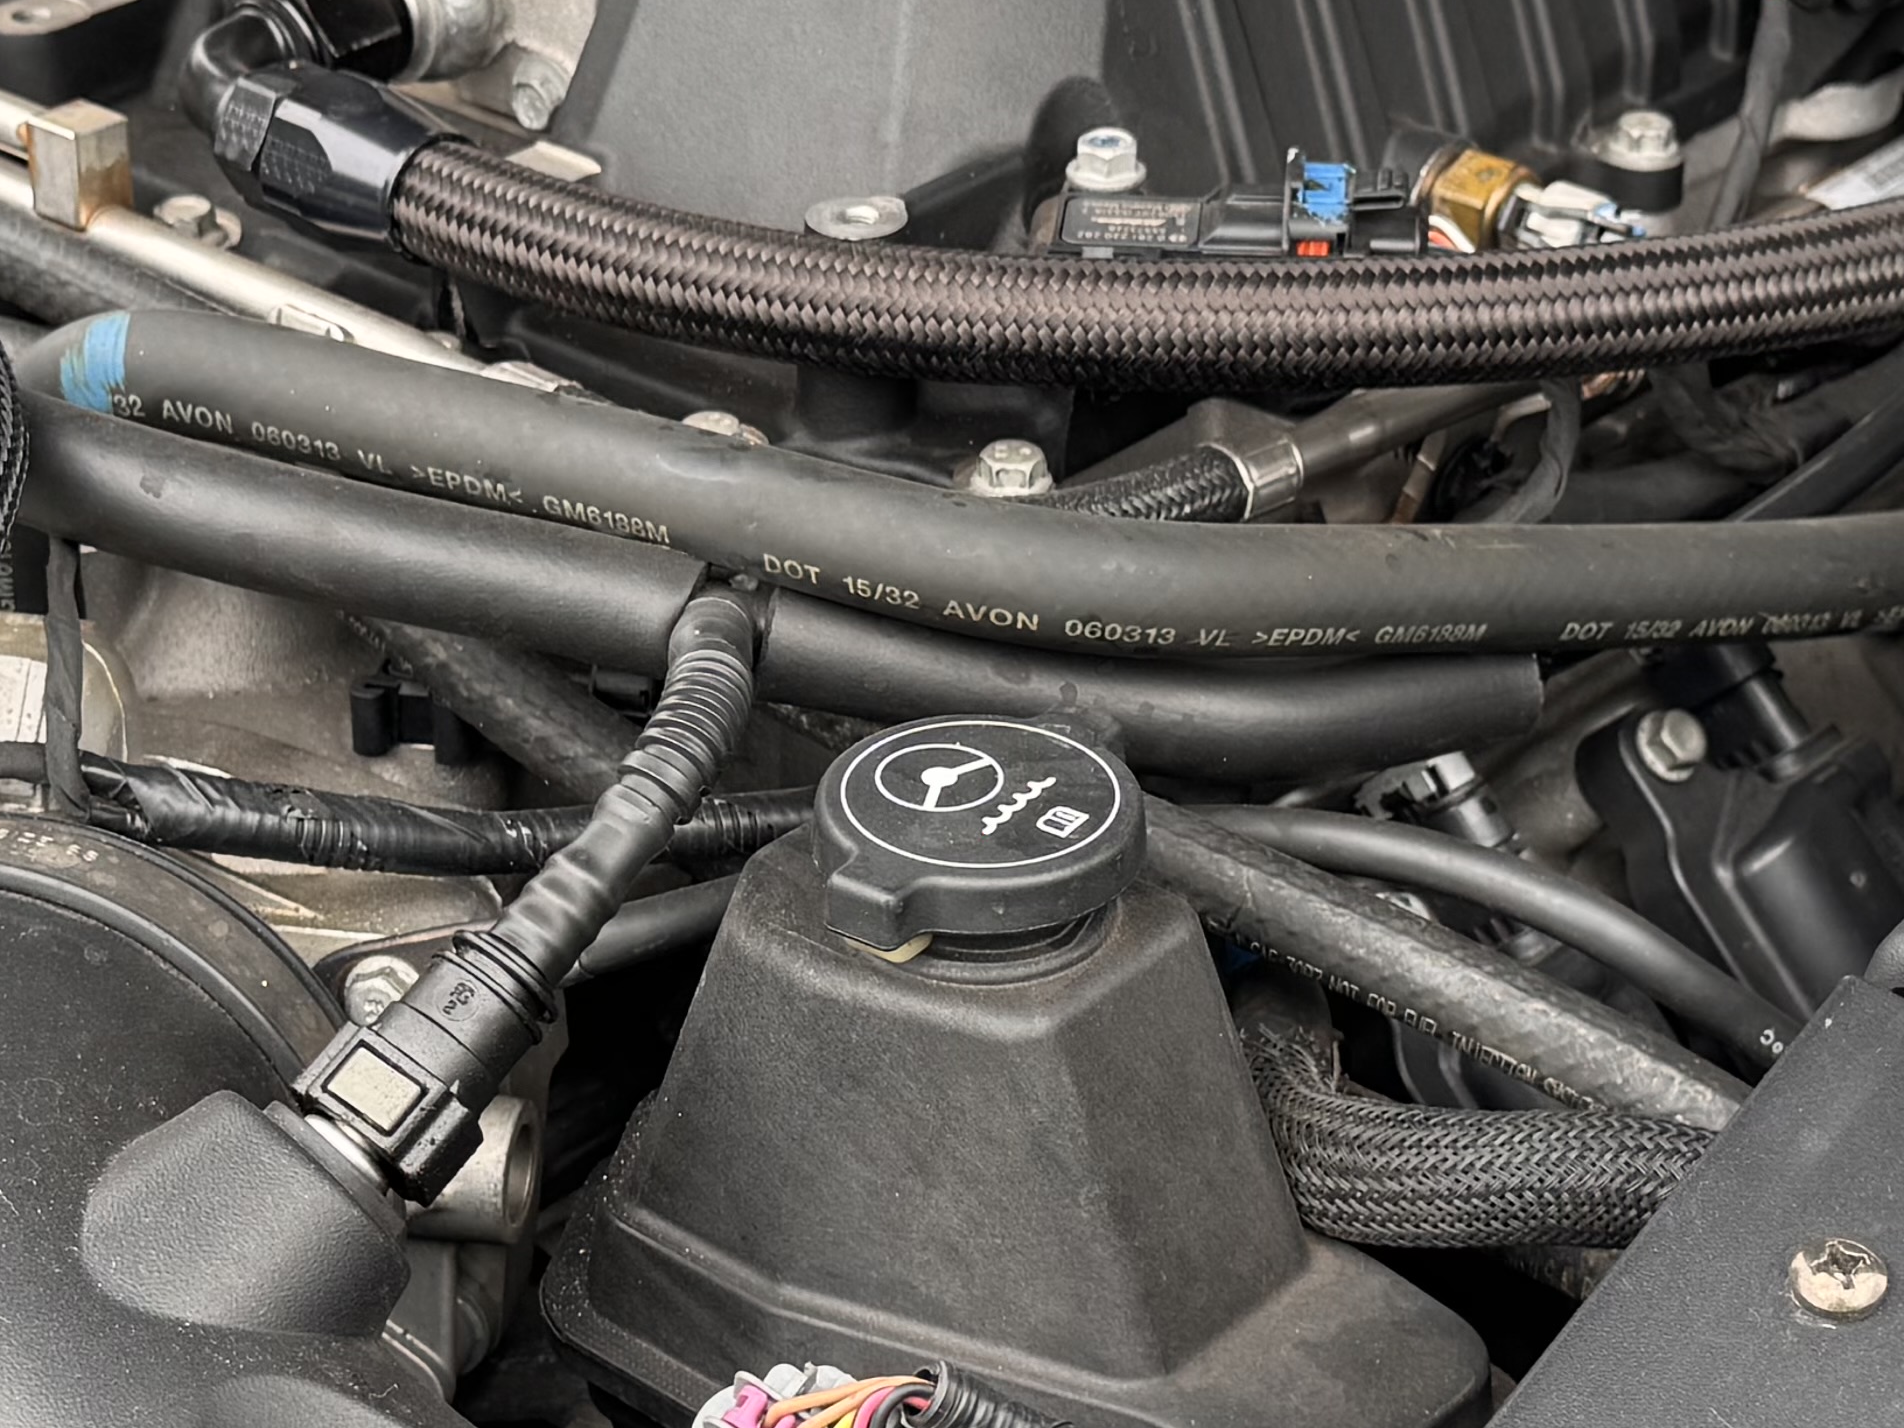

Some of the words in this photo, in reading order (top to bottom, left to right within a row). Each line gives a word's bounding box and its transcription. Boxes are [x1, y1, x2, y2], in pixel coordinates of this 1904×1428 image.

[162, 399, 234, 435] AVON
[251, 422, 342, 461] 060313
[542, 495, 671, 545] GM6188M
[763, 553, 821, 585] DOT
[842, 575, 921, 610] 15/32
[943, 600, 1040, 632] AVON
[1065, 619, 1177, 646] 060313
[1251, 627, 1361, 648] >EPDM<
[1374, 623, 1488, 645] GM6188M
[1559, 620, 1614, 641] DOT
[1623, 619, 1683, 640] 15/32
